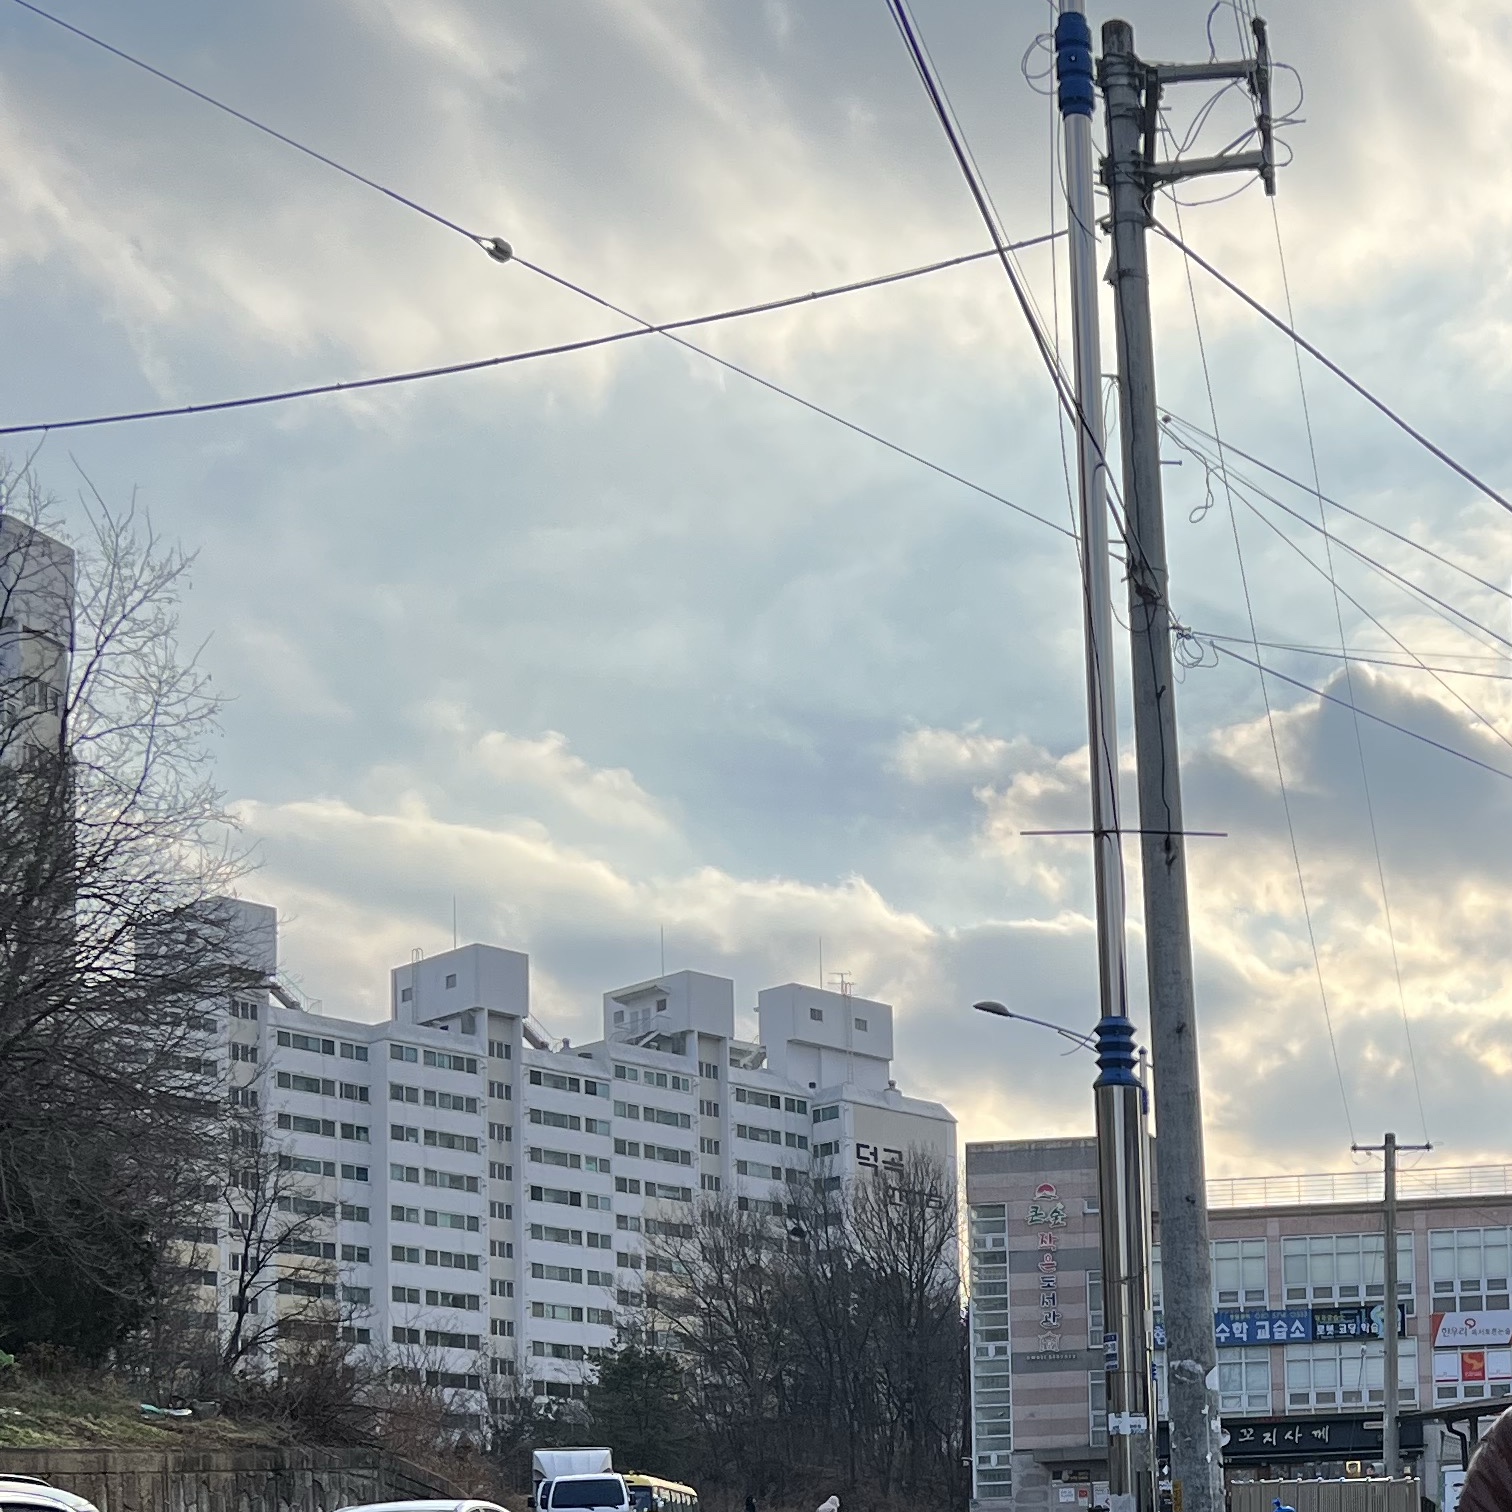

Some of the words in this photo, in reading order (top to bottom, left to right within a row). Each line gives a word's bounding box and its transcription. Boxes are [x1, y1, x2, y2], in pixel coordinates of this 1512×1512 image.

[856, 1143, 904, 1179] 덕곡
[1215, 1322, 1249, 1342] 수학
[1255, 1319, 1306, 1340] 교습소
